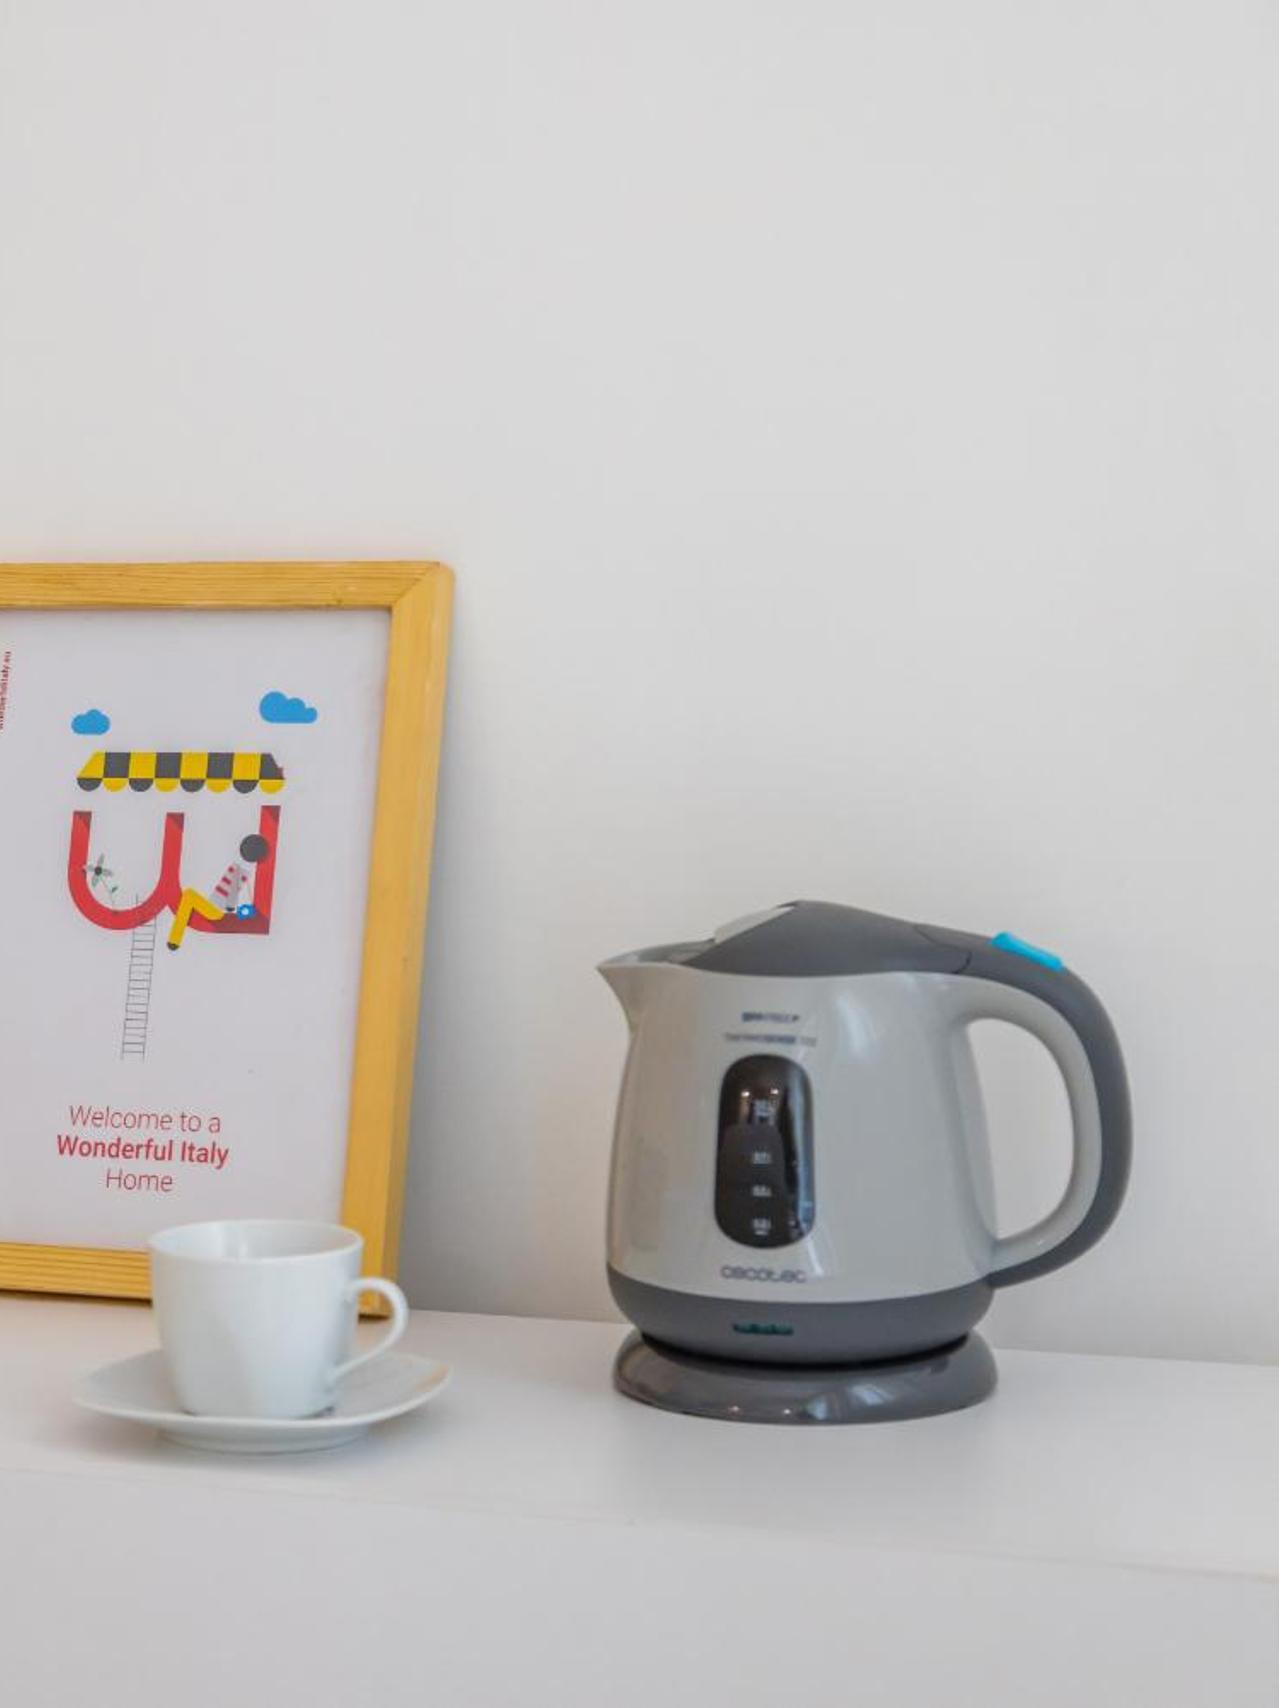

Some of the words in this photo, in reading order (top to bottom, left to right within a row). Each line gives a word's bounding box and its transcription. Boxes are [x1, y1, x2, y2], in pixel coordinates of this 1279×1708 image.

[69, 1105, 173, 1131] Welcome
[180, 1111, 202, 1133] to
[208, 1115, 222, 1134] a
[56, 1134, 175, 1162] Wonderful
[180, 1140, 230, 1171] Italy
[105, 1167, 174, 1193] Home
